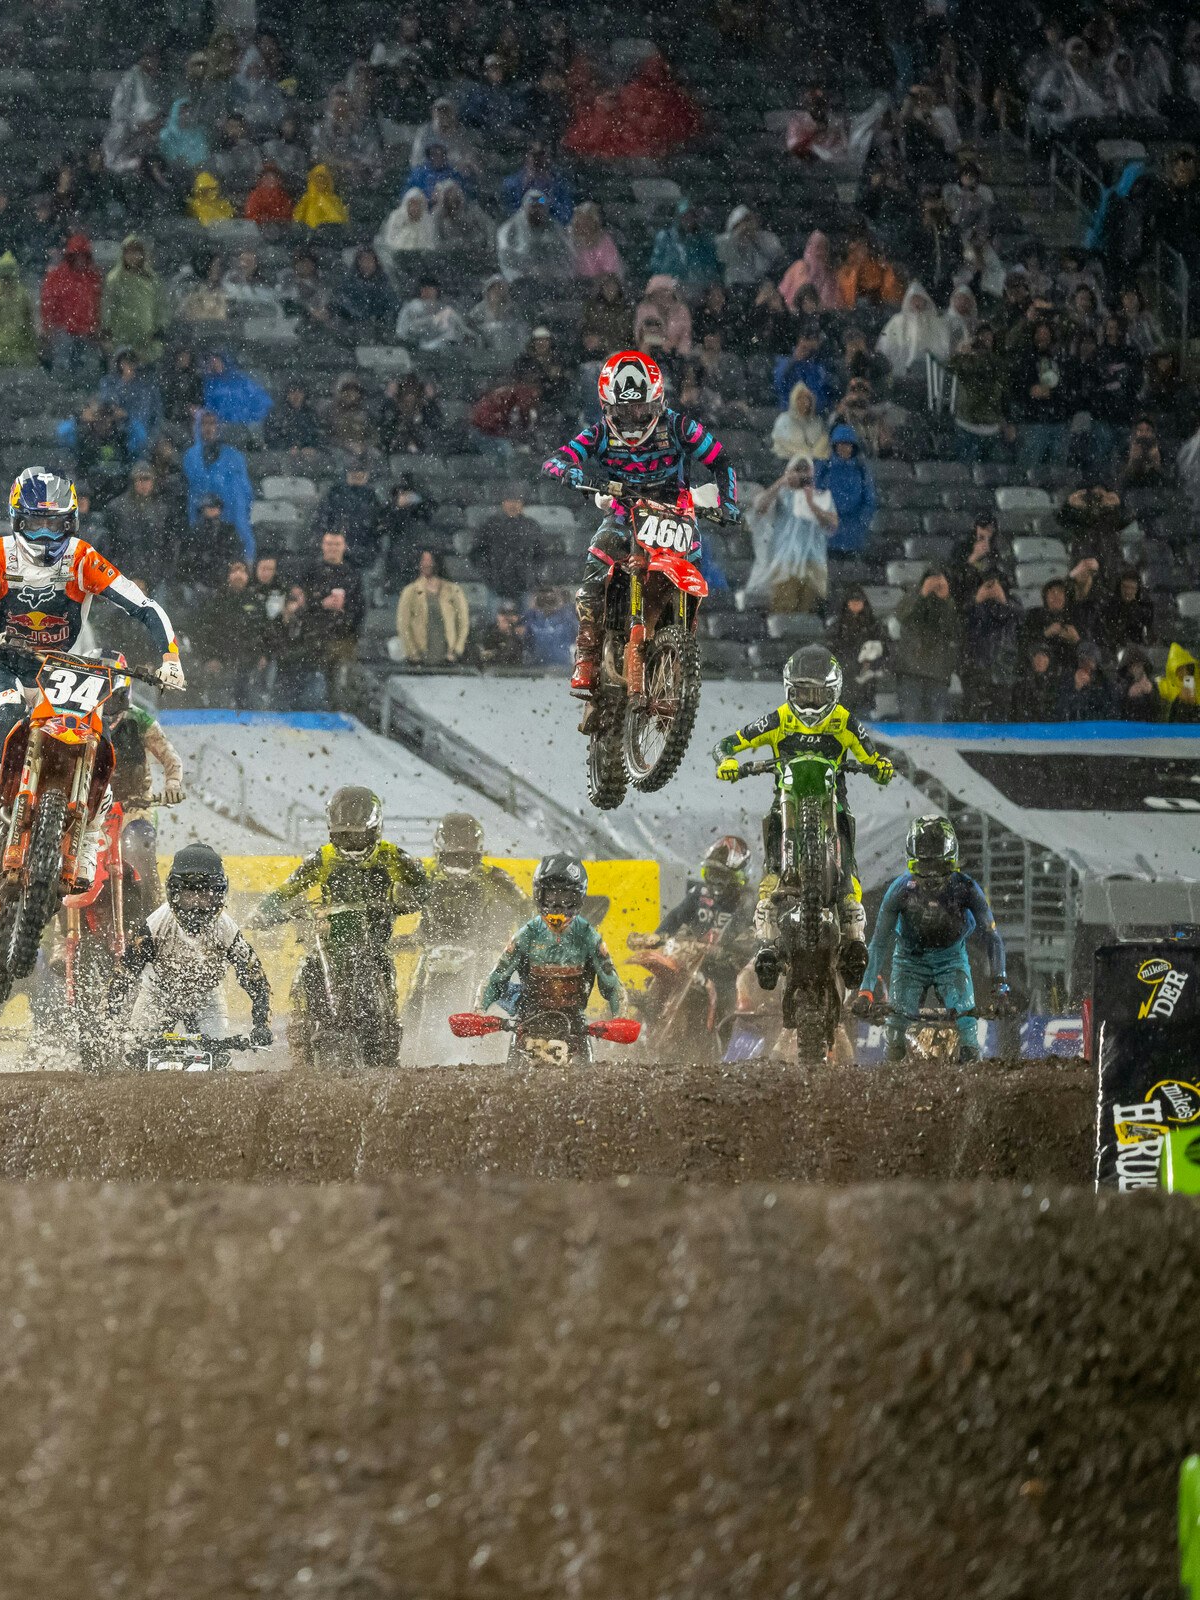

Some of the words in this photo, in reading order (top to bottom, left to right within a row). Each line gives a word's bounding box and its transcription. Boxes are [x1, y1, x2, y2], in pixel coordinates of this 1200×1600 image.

[637, 515, 693, 552] 460
[38, 626, 70, 643] Bull
[169, 661, 179, 679] FOX
[44, 669, 105, 712] 34
[799, 734, 822, 743] FOX
[1140, 962, 1169, 981] mike's
[1160, 1083, 1194, 1120] mike's
